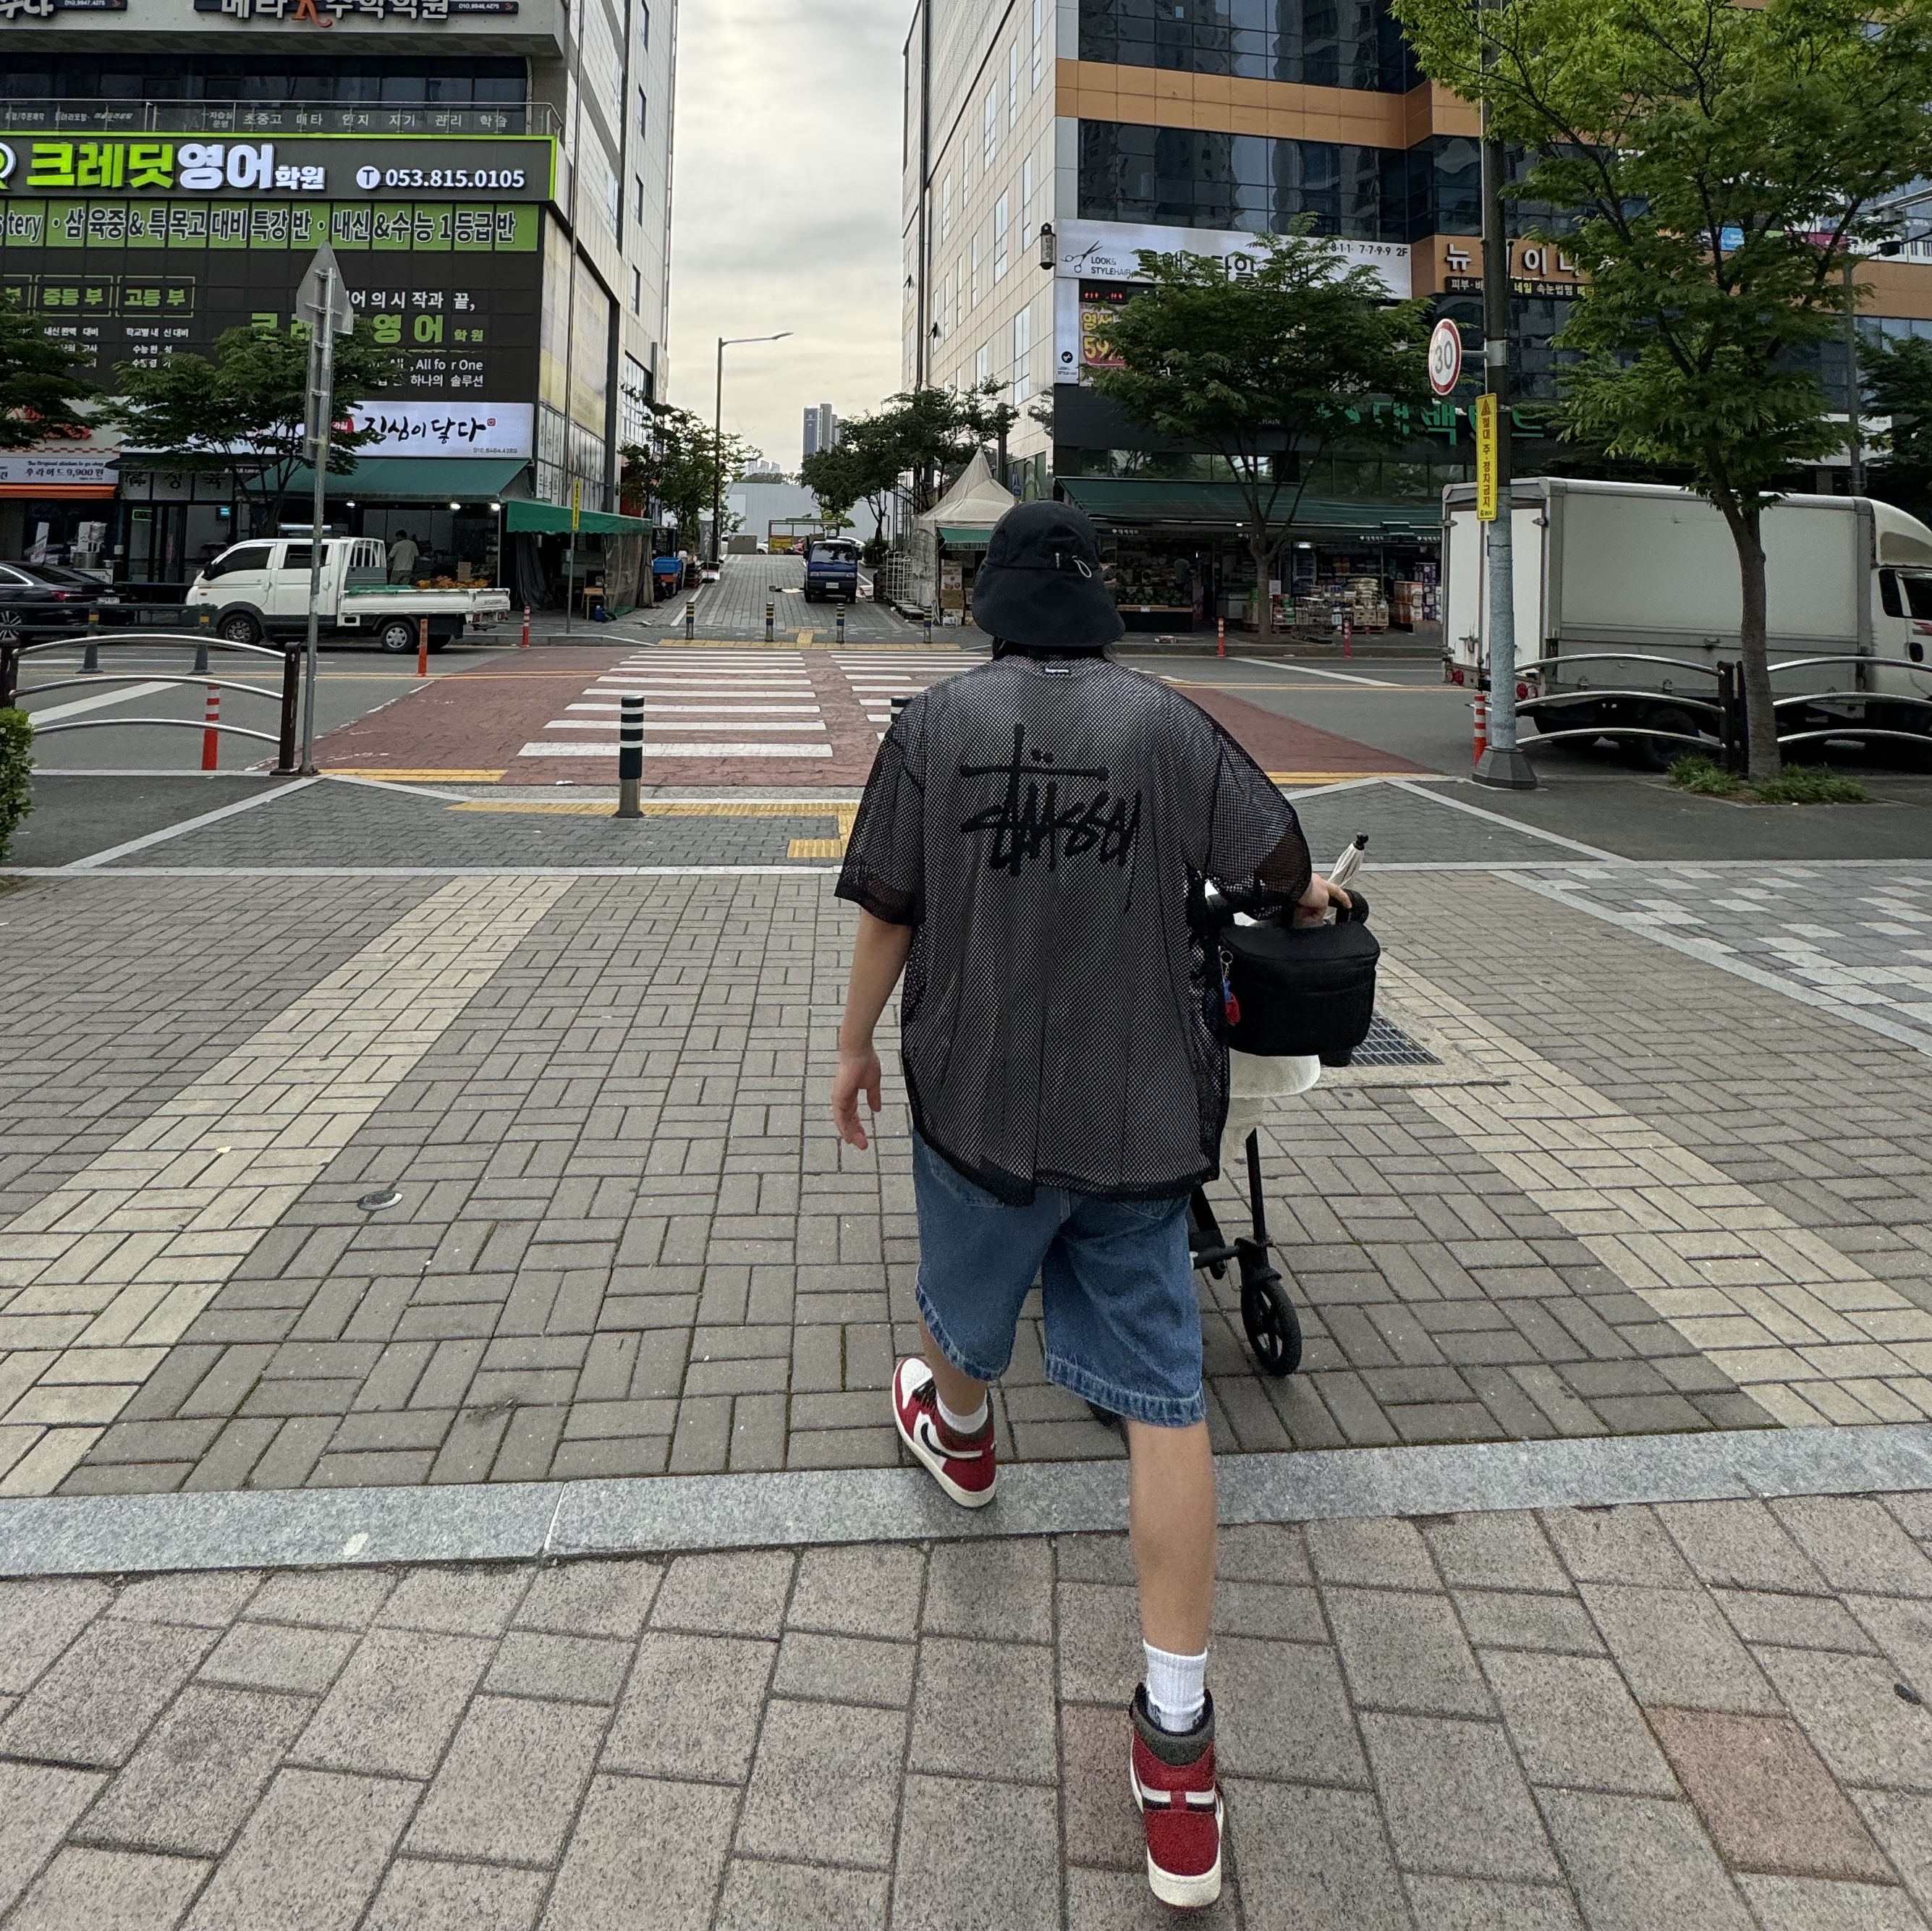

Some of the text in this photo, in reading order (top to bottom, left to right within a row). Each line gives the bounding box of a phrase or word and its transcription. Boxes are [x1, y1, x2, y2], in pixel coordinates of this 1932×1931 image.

[243, 113, 282, 125] 초중고
[386, 169, 525, 188] 053.815.0105
[1396, 247, 1408, 257] 2F
[1091, 256, 1117, 266] LOOK&
[454, 292, 475, 310] 끝,
[459, 359, 483, 370] One
[1435, 342, 1454, 375] 30
[410, 375, 444, 387] 하나의
[451, 375, 483, 388] 솔루션
